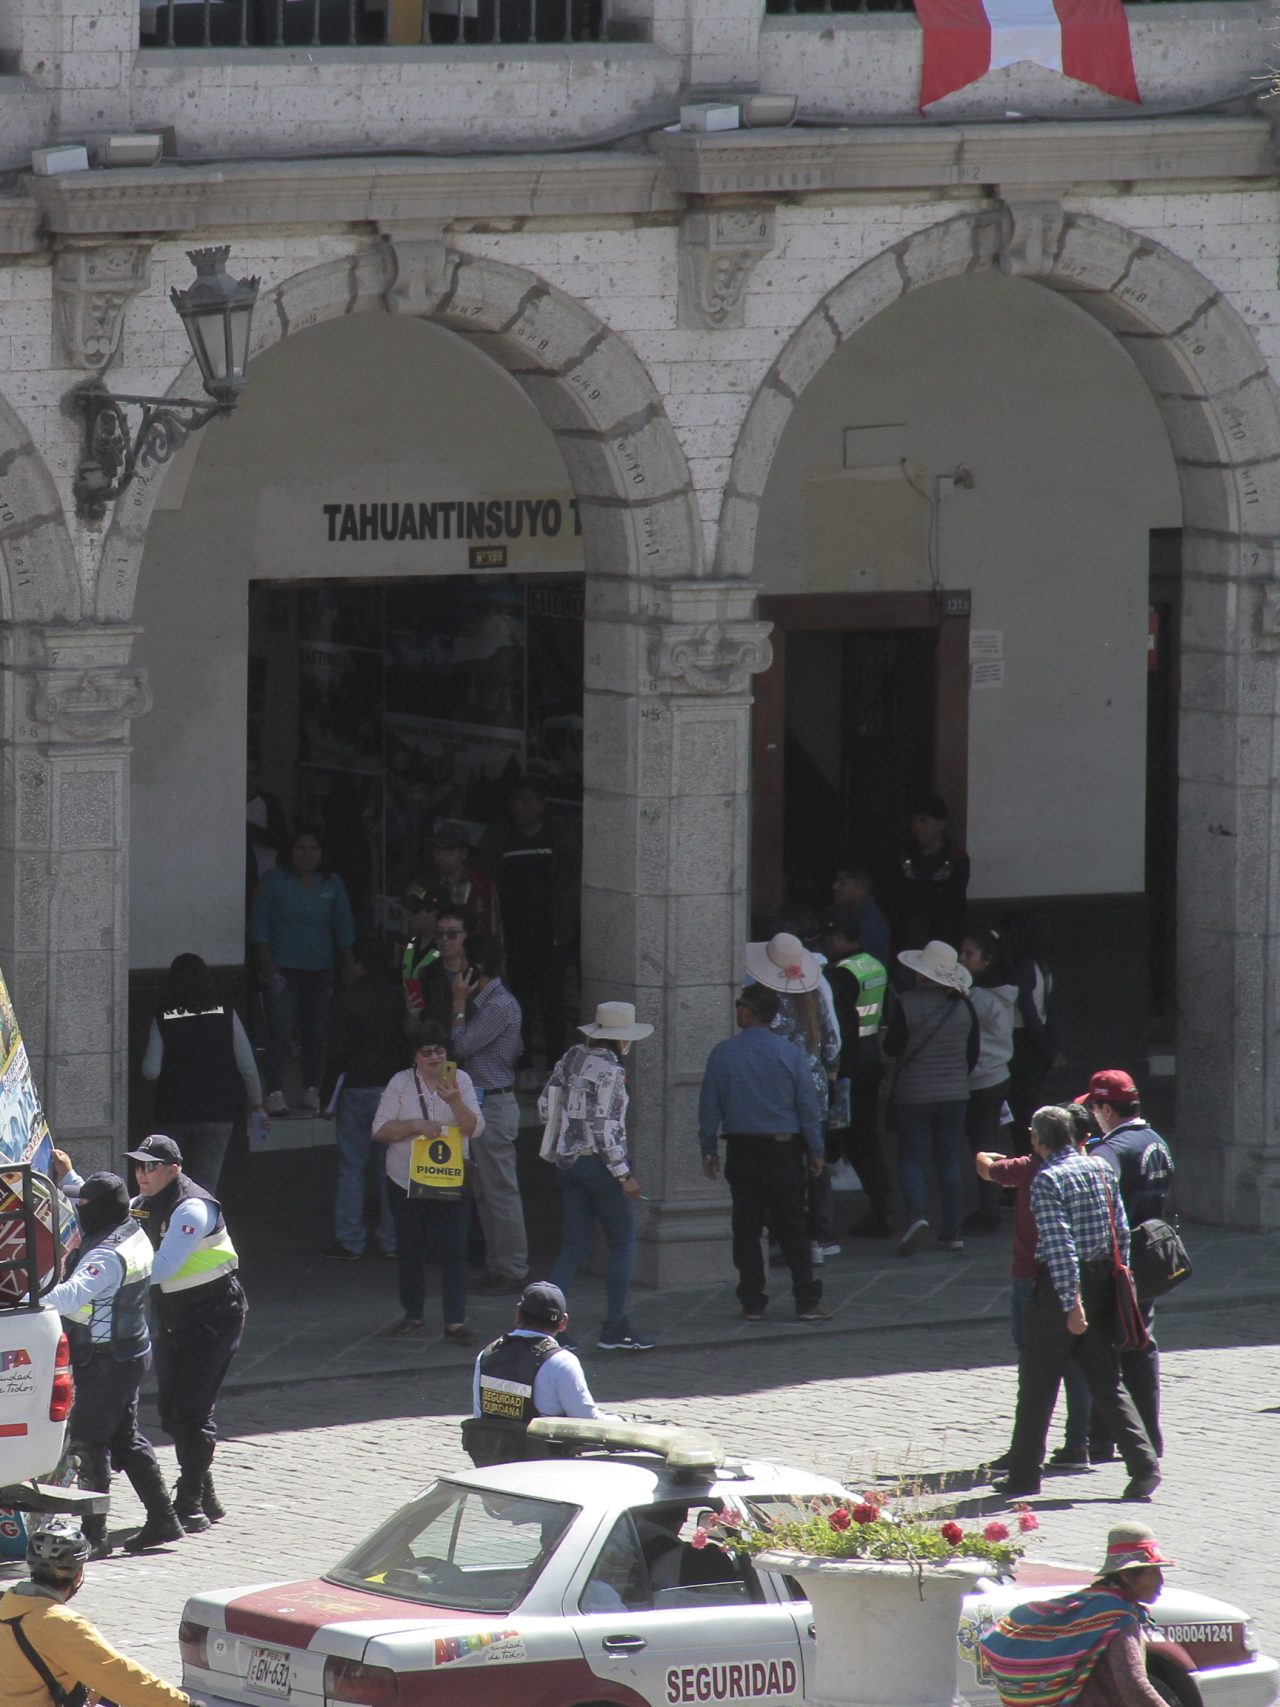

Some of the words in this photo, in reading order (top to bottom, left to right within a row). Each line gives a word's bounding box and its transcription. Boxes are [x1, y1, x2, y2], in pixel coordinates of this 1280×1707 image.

[323, 499, 563, 542] TAHUANTINSUYO
[416, 1164, 462, 1177] PIONIER
[483, 1389, 522, 1407] SEGURIDAD
[1167, 1624, 1233, 1643] 080041241
[434, 1629, 520, 1666] AREQUIPA
[490, 1642, 523, 1652] ciudad
[488, 1652, 500, 1661] de
[667, 1659, 797, 1704] SEGURIDAD
